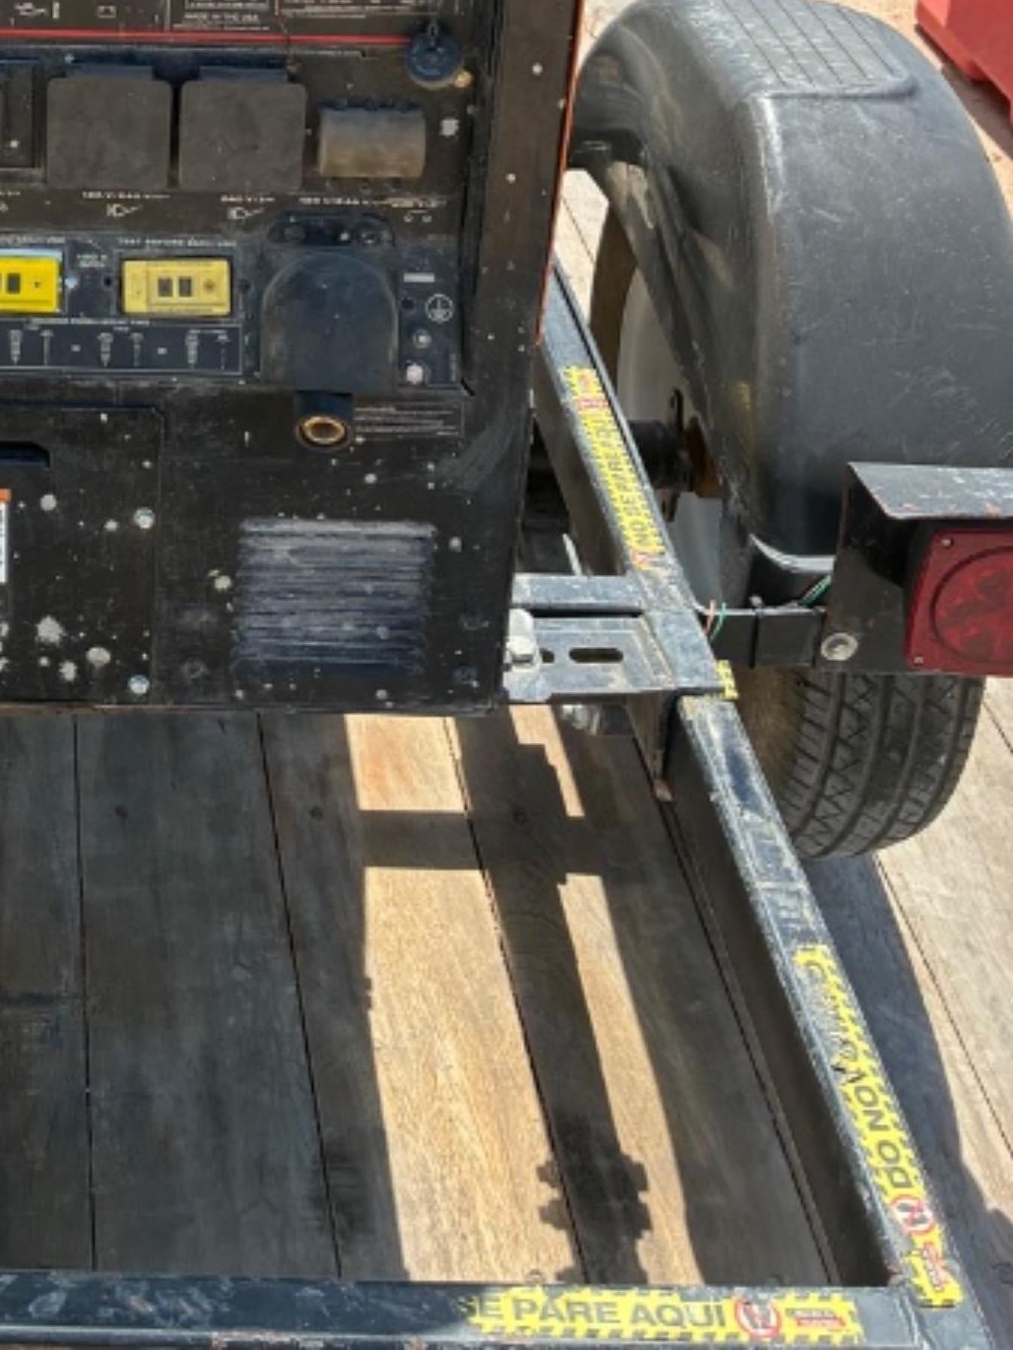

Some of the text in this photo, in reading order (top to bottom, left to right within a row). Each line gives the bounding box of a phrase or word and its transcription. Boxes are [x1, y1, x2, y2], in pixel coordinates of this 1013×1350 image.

[877, 1139, 913, 1189] DO
[512, 1296, 622, 1325] PARE
[629, 1302, 728, 1331] AQUI
